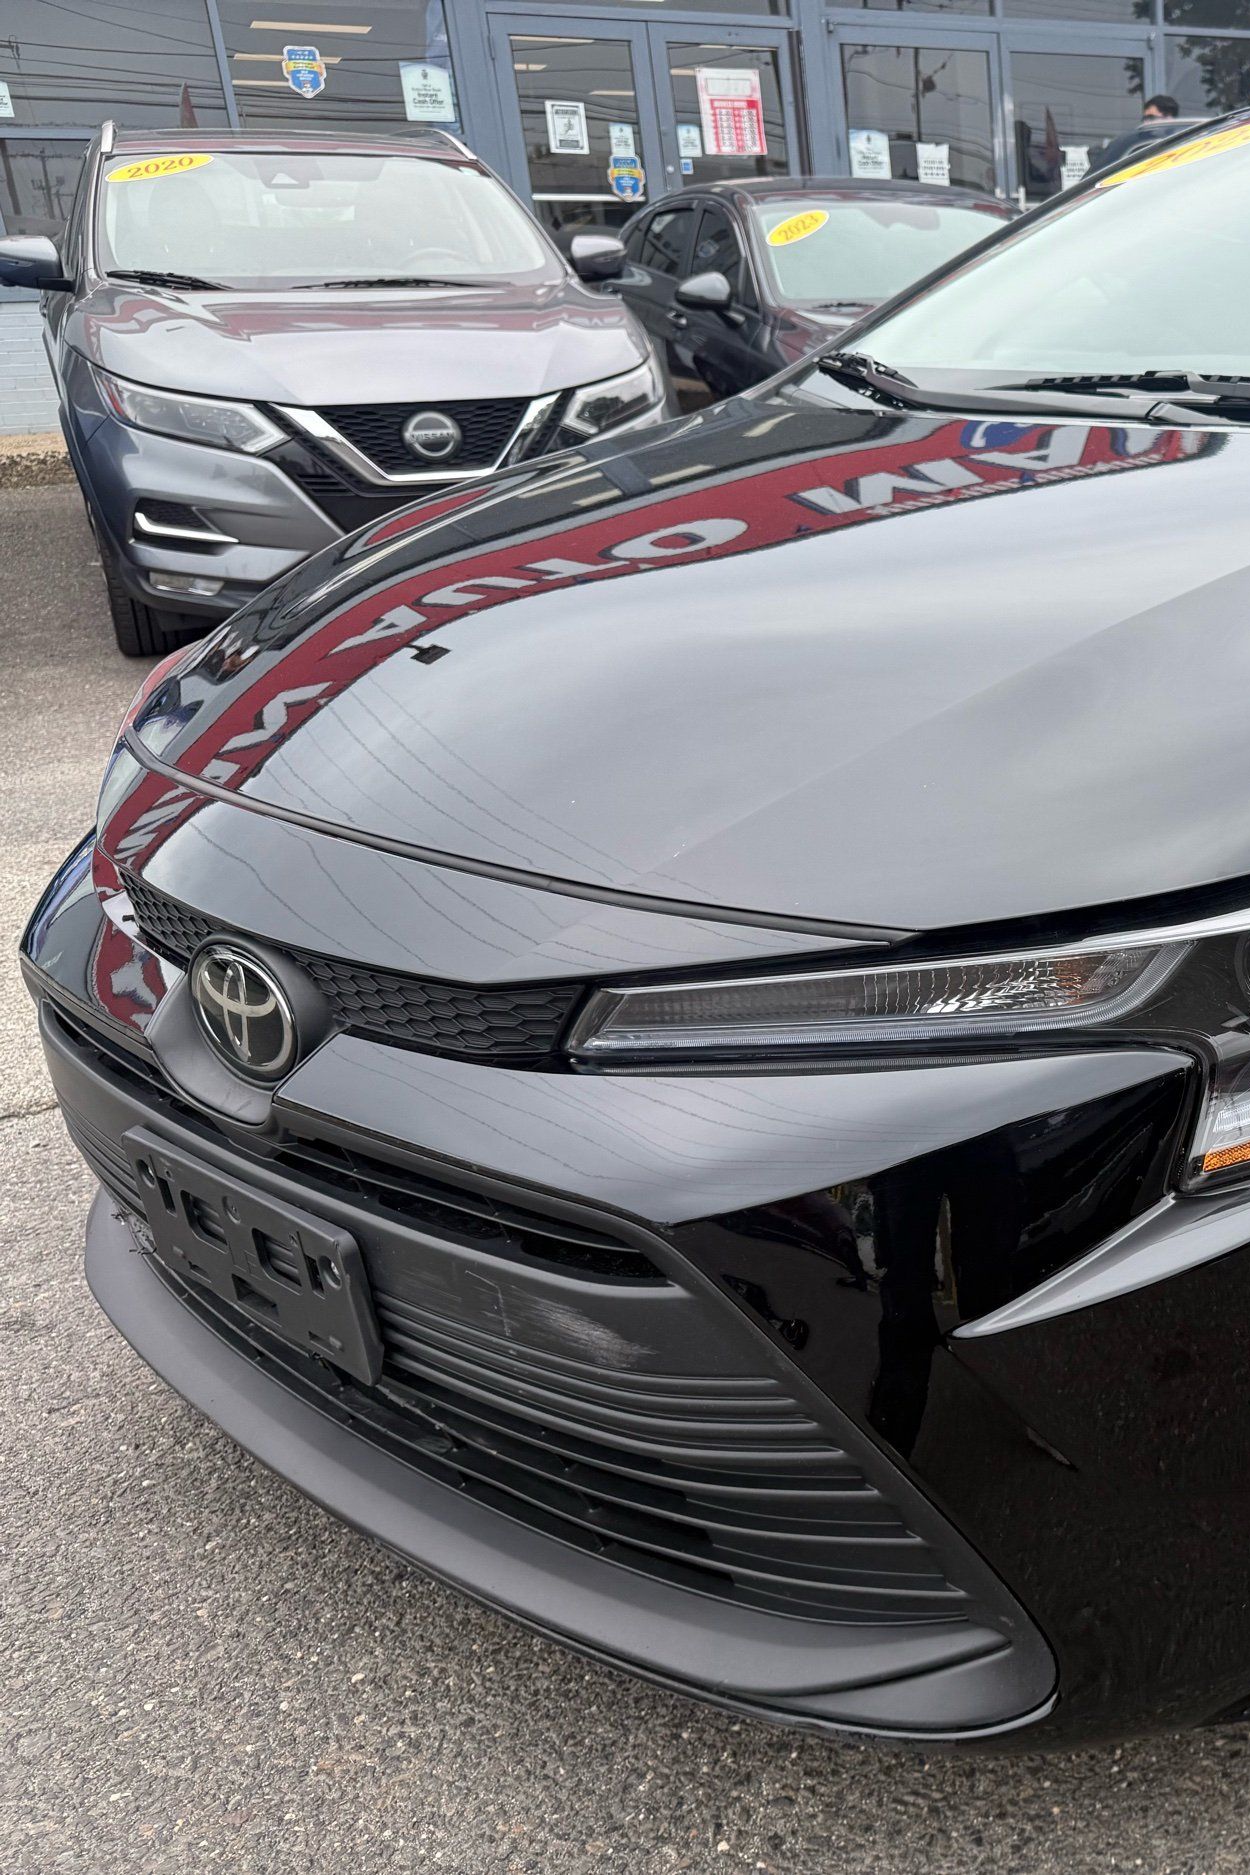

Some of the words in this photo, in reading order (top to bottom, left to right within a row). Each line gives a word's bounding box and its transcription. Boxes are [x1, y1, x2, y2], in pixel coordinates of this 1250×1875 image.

[127, 156, 194, 179] 2020
[778, 214, 819, 241] 2023
[410, 431, 455, 442] NISSAN
